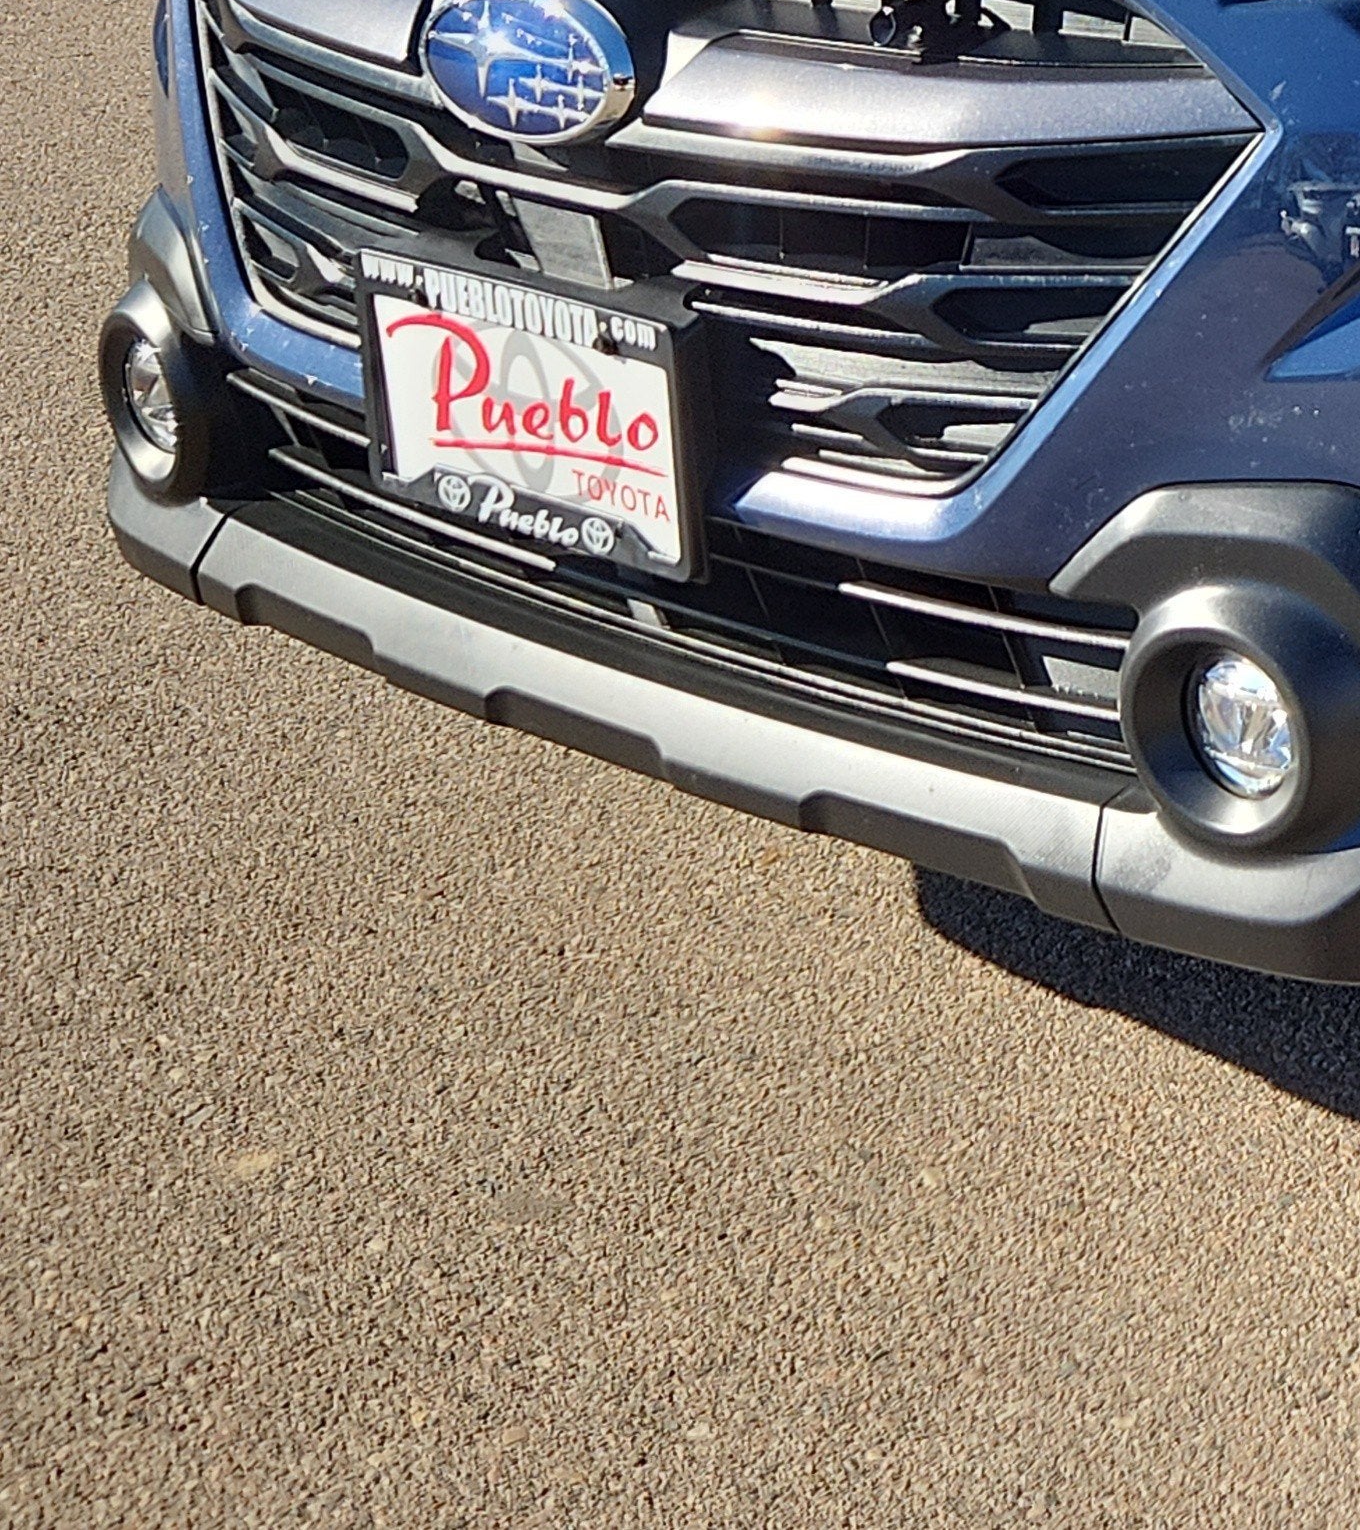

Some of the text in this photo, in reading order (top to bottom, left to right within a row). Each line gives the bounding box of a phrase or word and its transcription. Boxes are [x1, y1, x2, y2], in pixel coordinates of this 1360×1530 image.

[386, 311, 659, 451] Pueblo
[466, 473, 580, 548] Pueblo
[571, 470, 671, 523] TOYOTA
